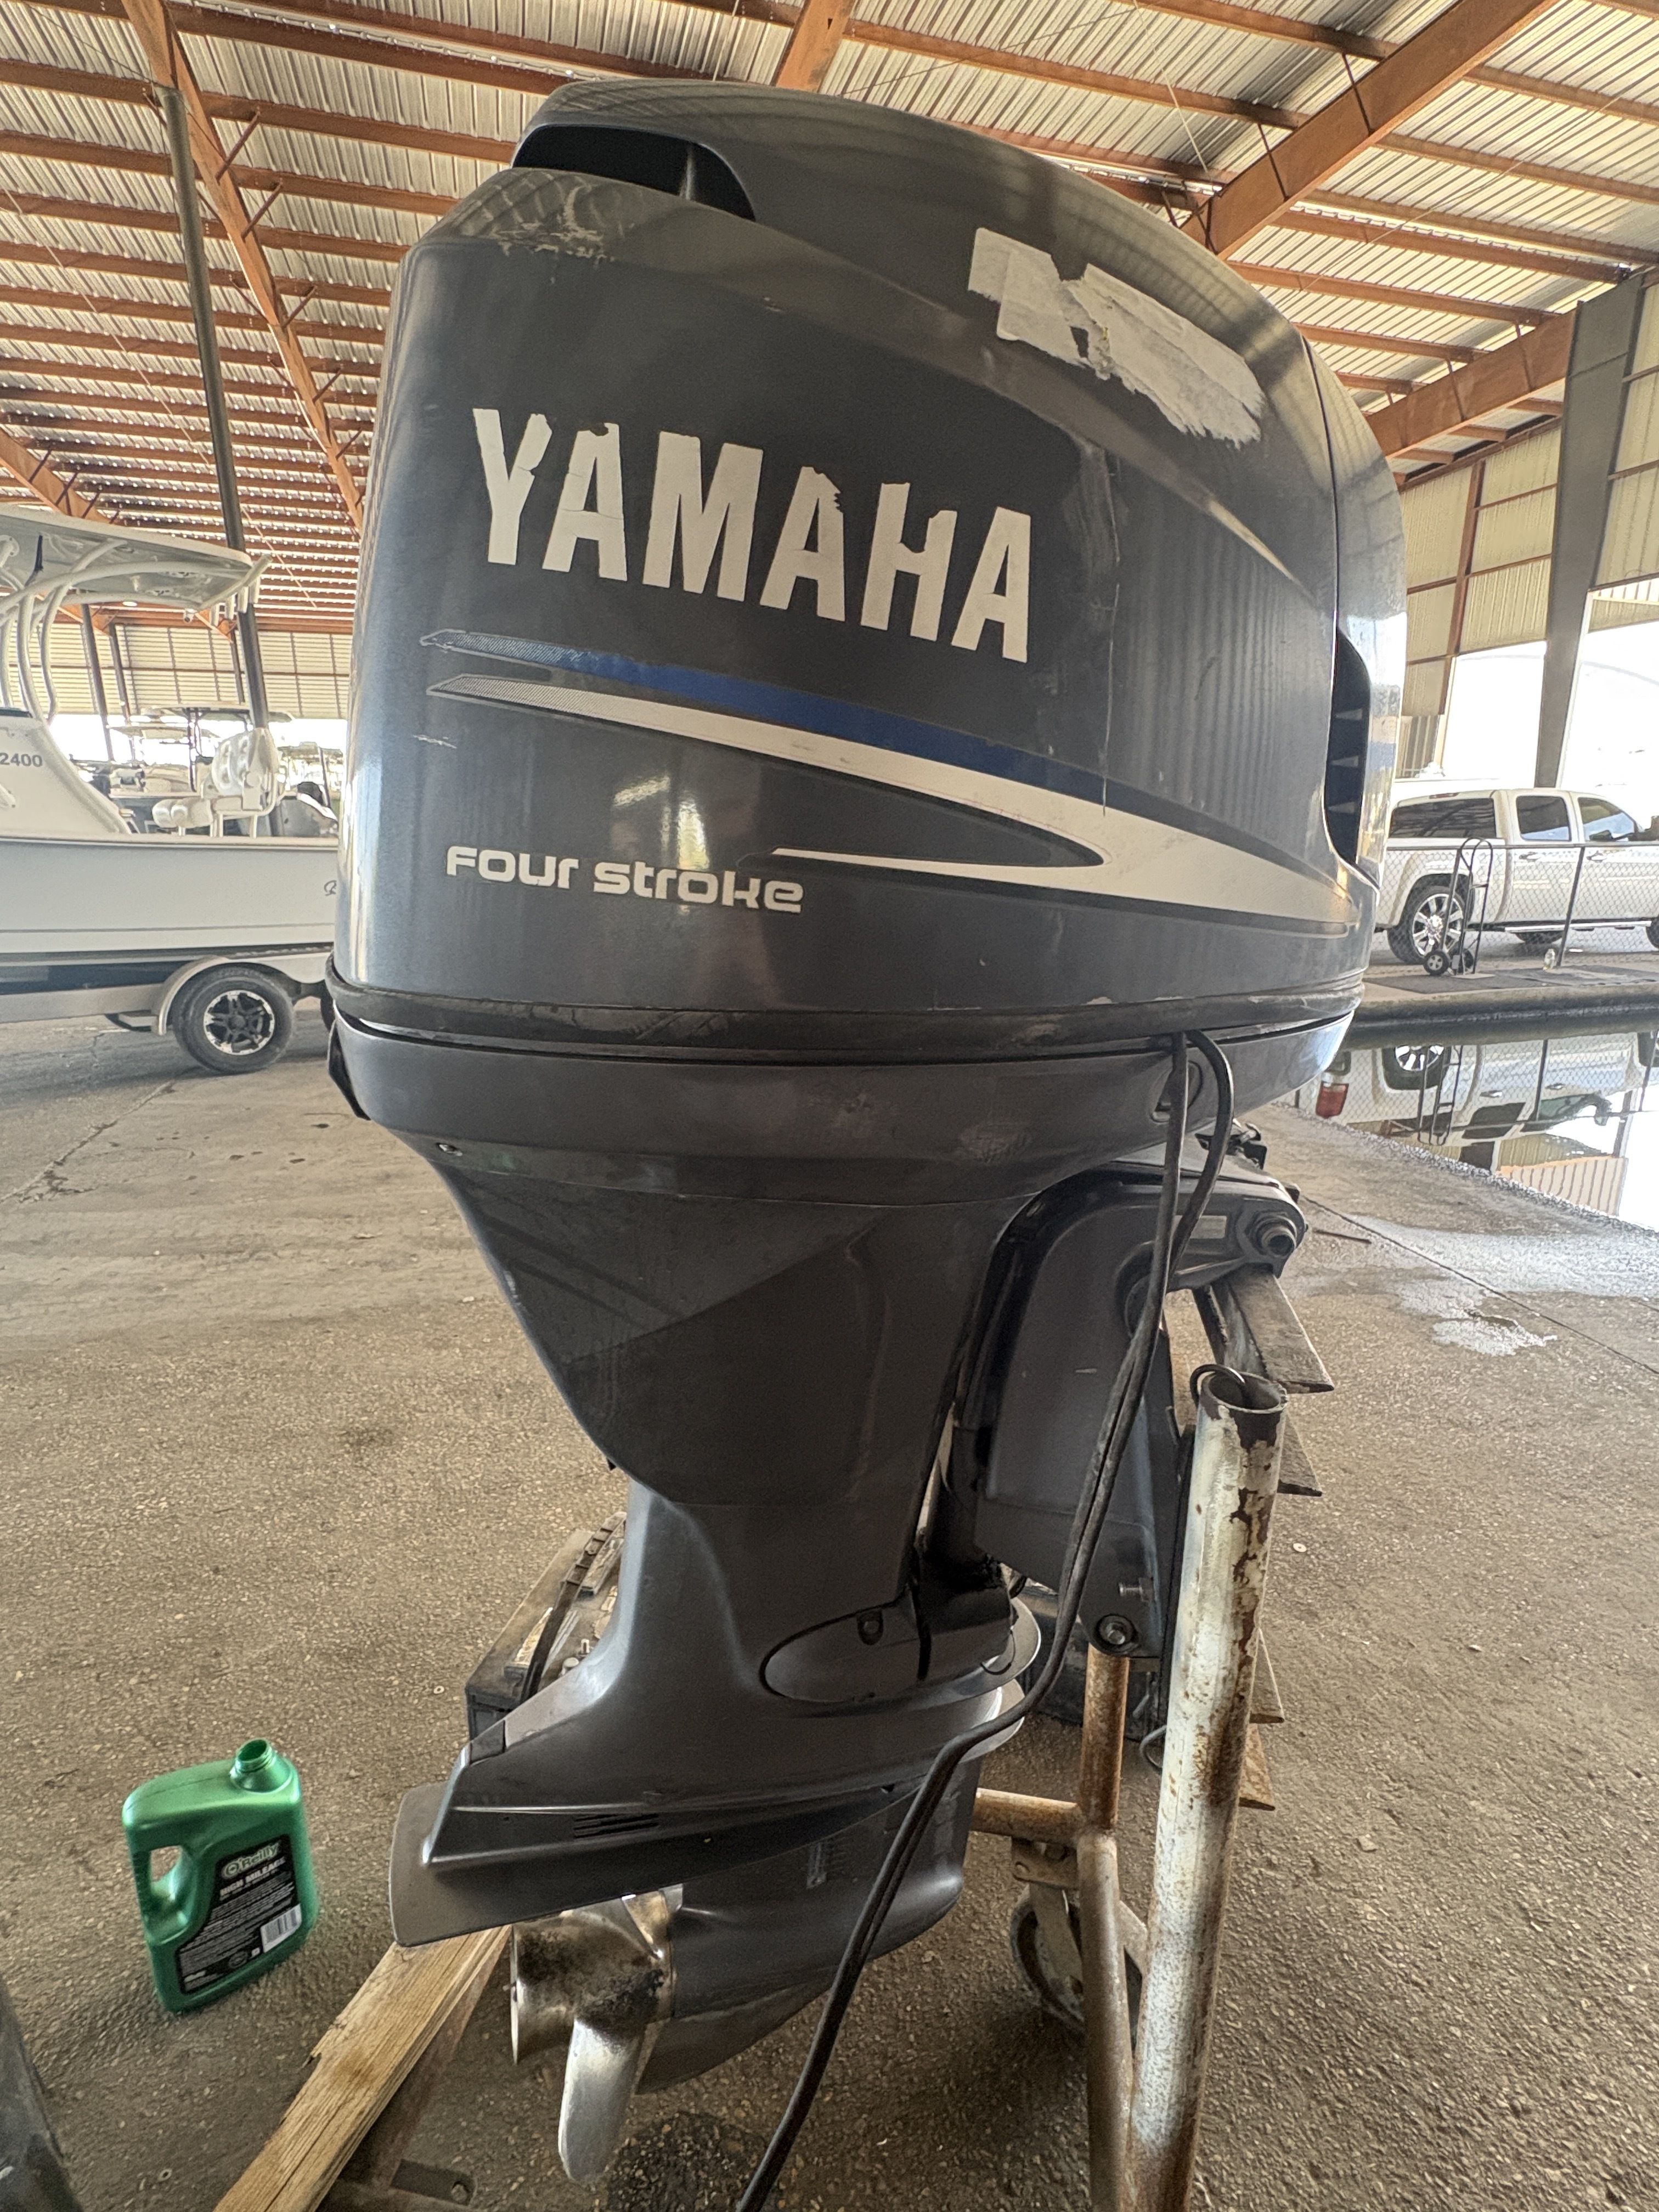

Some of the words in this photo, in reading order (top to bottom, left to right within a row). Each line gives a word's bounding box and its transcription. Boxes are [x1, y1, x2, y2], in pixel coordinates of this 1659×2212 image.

[473, 408, 1031, 663] YAMAHA
[0, 752, 43, 768] 2400
[222, 1843, 279, 1879] O'Reilly
